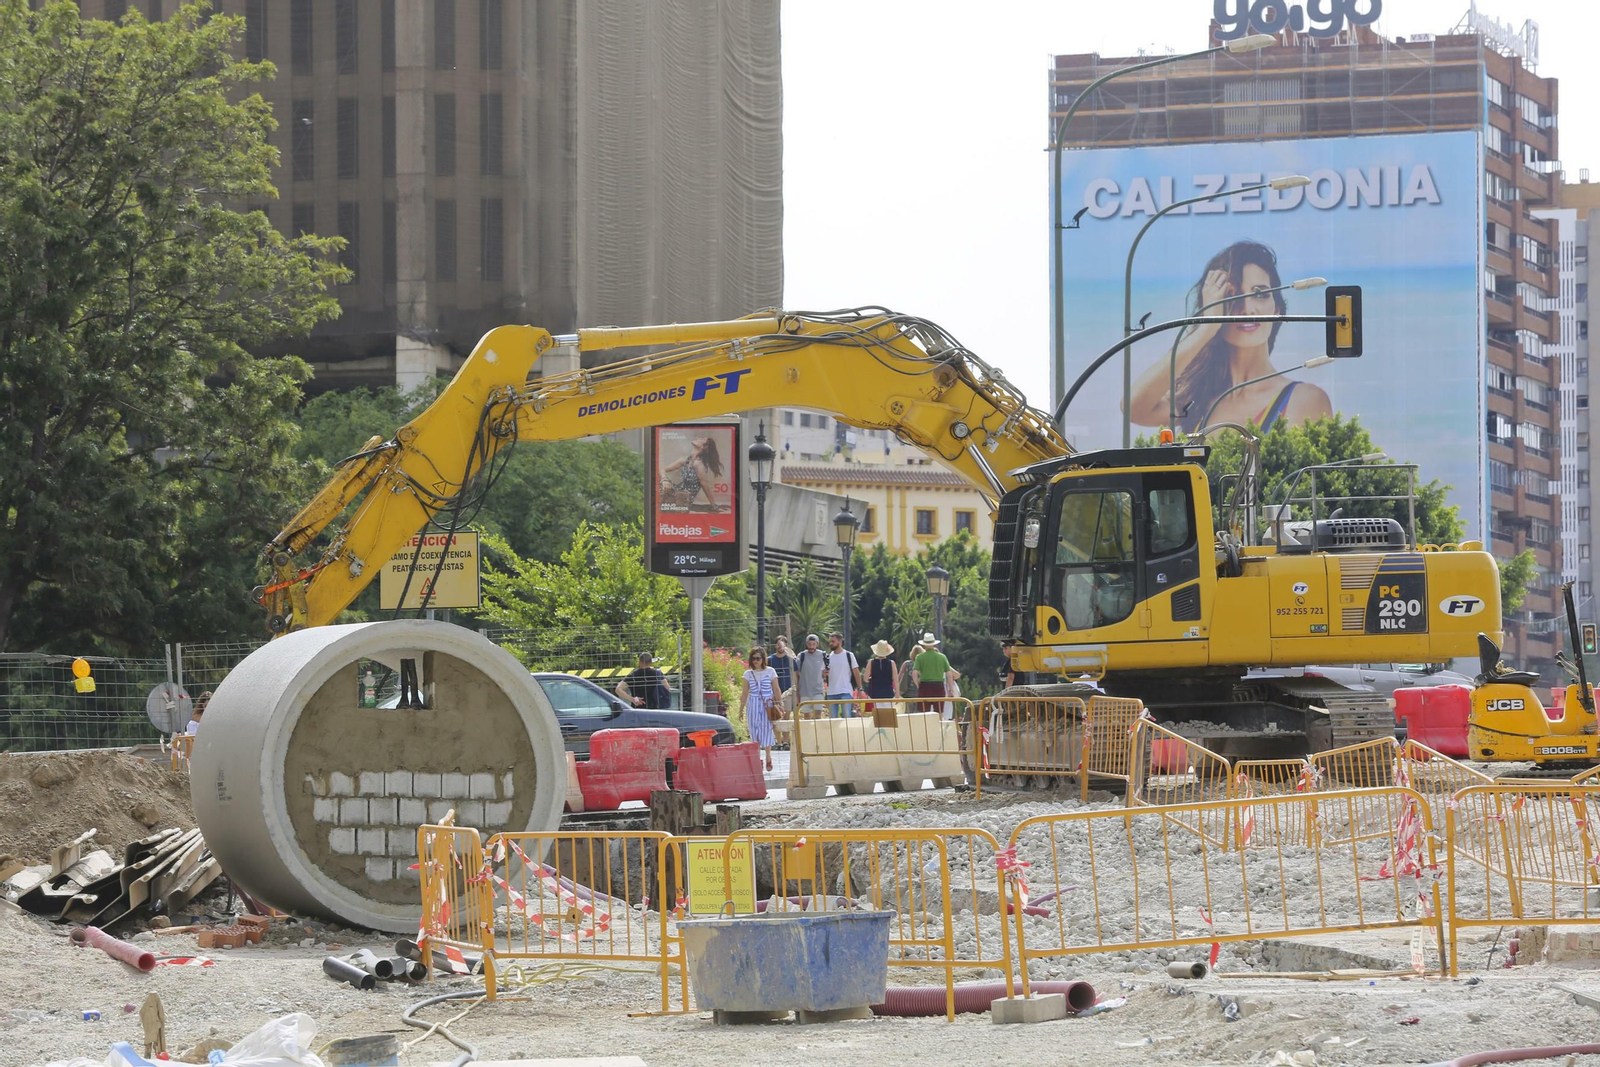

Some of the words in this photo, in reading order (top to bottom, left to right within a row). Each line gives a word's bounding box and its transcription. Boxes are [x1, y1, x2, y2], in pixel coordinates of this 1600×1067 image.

[1083, 164, 1441, 219] CALZEDONIA
[577, 386, 687, 417] DEMOLICIONES
[691, 368, 752, 402] FT
[714, 484, 728, 493] 50
[659, 525, 702, 538] rebajas
[402, 533, 457, 547] TENCIÓN
[420, 550, 472, 560] COEXITENCIA
[1379, 585, 1400, 598] PC
[1276, 607, 1291, 616] 952
[1293, 607, 1308, 615] 255
[1310, 607, 1324, 615] 721
[1378, 599, 1421, 617] 290
[1447, 599, 1480, 614] FT
[1380, 618, 1406, 629] NLC
[1487, 699, 1524, 711] JCB
[1541, 746, 1574, 755] 8008
[697, 845, 744, 860] ATENÓN
[699, 866, 716, 874] CALLE
[706, 876, 718, 884] POR
[730, 889, 751, 897] UIOSCO)
